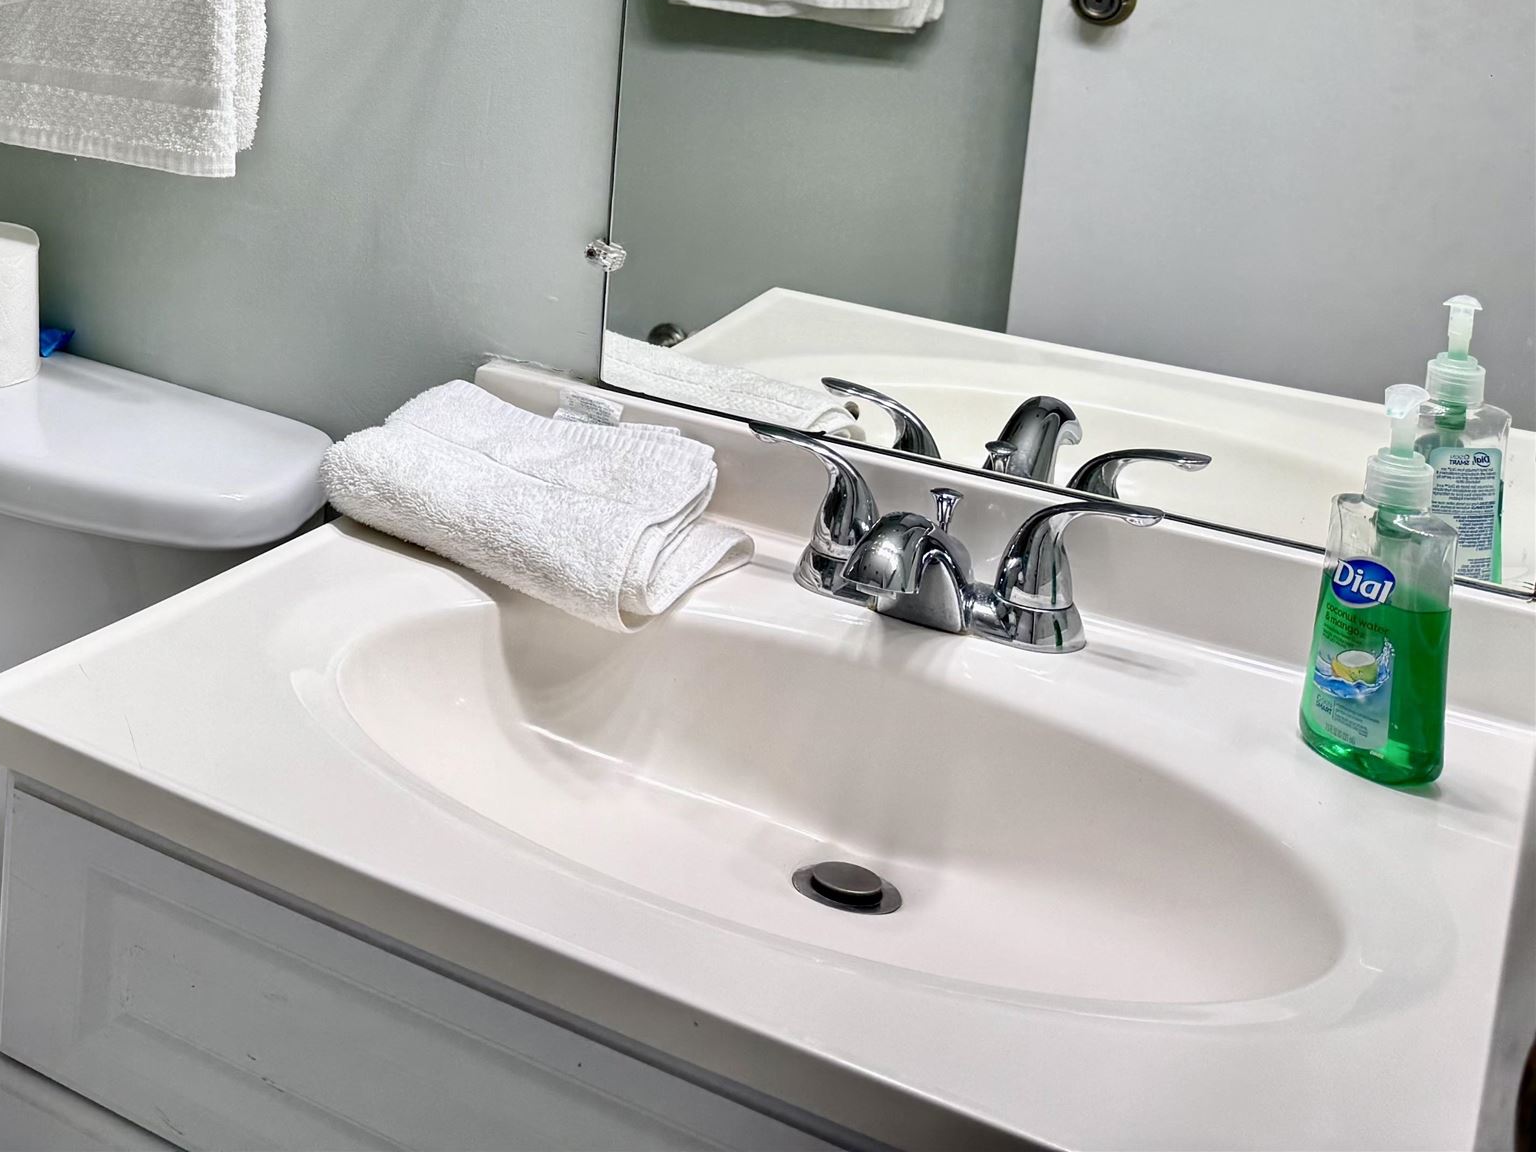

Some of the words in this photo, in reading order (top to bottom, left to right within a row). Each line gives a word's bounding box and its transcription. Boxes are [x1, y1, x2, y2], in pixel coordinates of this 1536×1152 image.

[1332, 558, 1394, 605] Dial
[1326, 602, 1358, 625] coconut
[1359, 617, 1392, 636] water
[1330, 616, 1360, 636] mango
